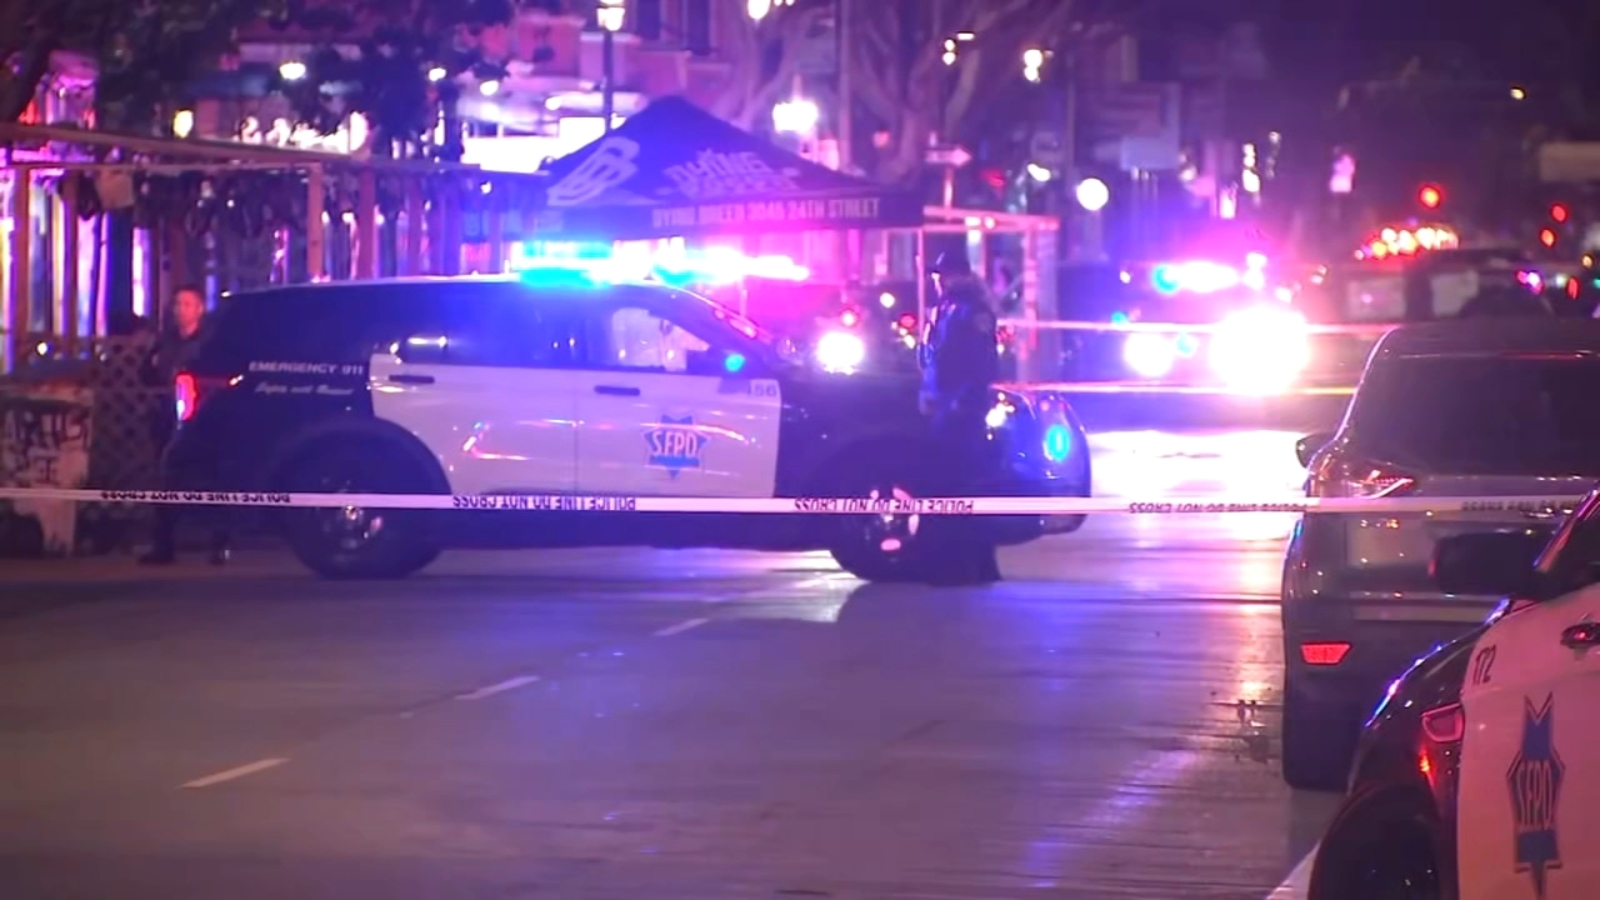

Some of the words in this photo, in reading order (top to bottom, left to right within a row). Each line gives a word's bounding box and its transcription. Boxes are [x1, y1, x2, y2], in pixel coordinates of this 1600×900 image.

[828, 197, 880, 219] STREET
[248, 361, 337, 374] EMERGENCY
[341, 364, 364, 375] 911
[242, 492, 291, 503] POLICE
[453, 495, 497, 508] CROSS
[501, 495, 528, 509] NOT
[534, 496, 550, 510] DO
[554, 496, 585, 510] LINE
[590, 496, 636, 510] POLICE
[794, 499, 837, 511] CROSS
[842, 499, 868, 511] NOT
[872, 499, 891, 511] DO
[894, 499, 924, 512] LINE
[928, 499, 974, 512] POLICE
[1129, 502, 1172, 513] CROSS
[1176, 503, 1202, 512] NOT
[1473, 644, 1497, 686] 172
